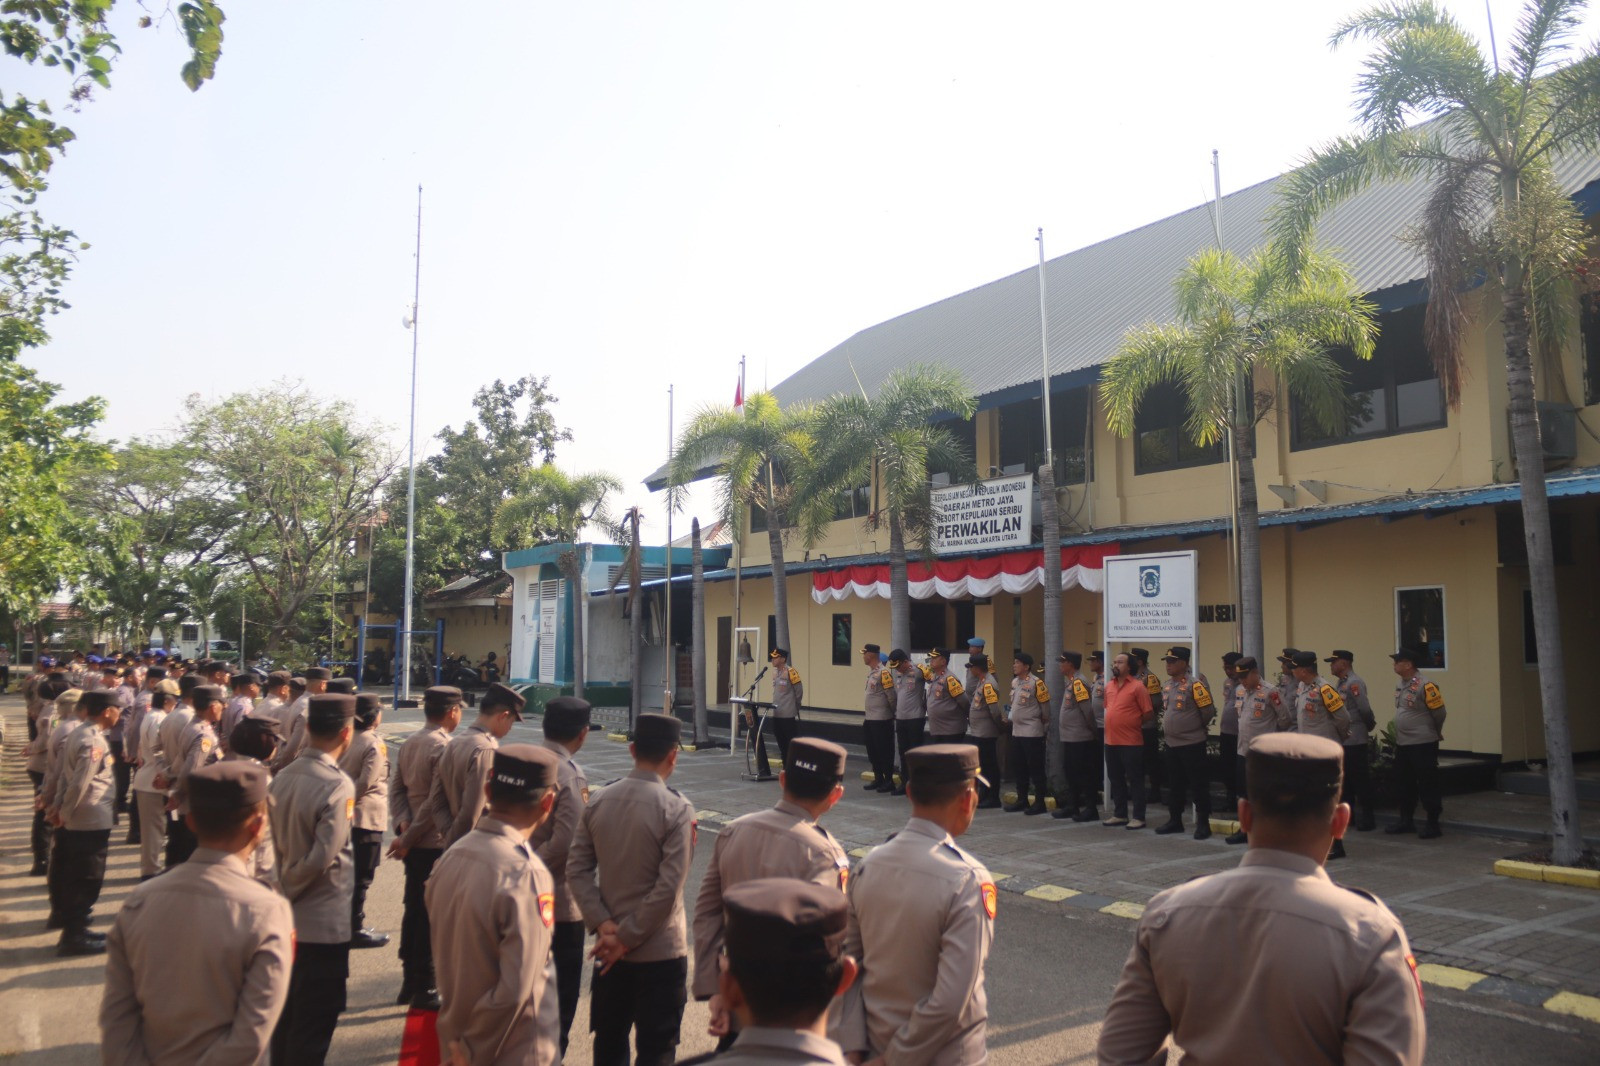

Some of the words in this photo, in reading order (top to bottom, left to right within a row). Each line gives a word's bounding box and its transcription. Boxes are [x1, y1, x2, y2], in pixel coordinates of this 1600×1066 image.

[1001, 481, 1026, 493] INDONESIA
[944, 502, 970, 512] DAERAH
[972, 498, 995, 508] METRO
[997, 495, 1014, 505] JAYA
[937, 513, 959, 524] RESORT
[960, 508, 997, 520] KEPULAUAN
[999, 505, 1022, 516] SERIBU
[937, 516, 1021, 539] PERWAKILAN
[980, 536, 1000, 544] JAKARTA
[1002, 533, 1018, 542] UTARA
